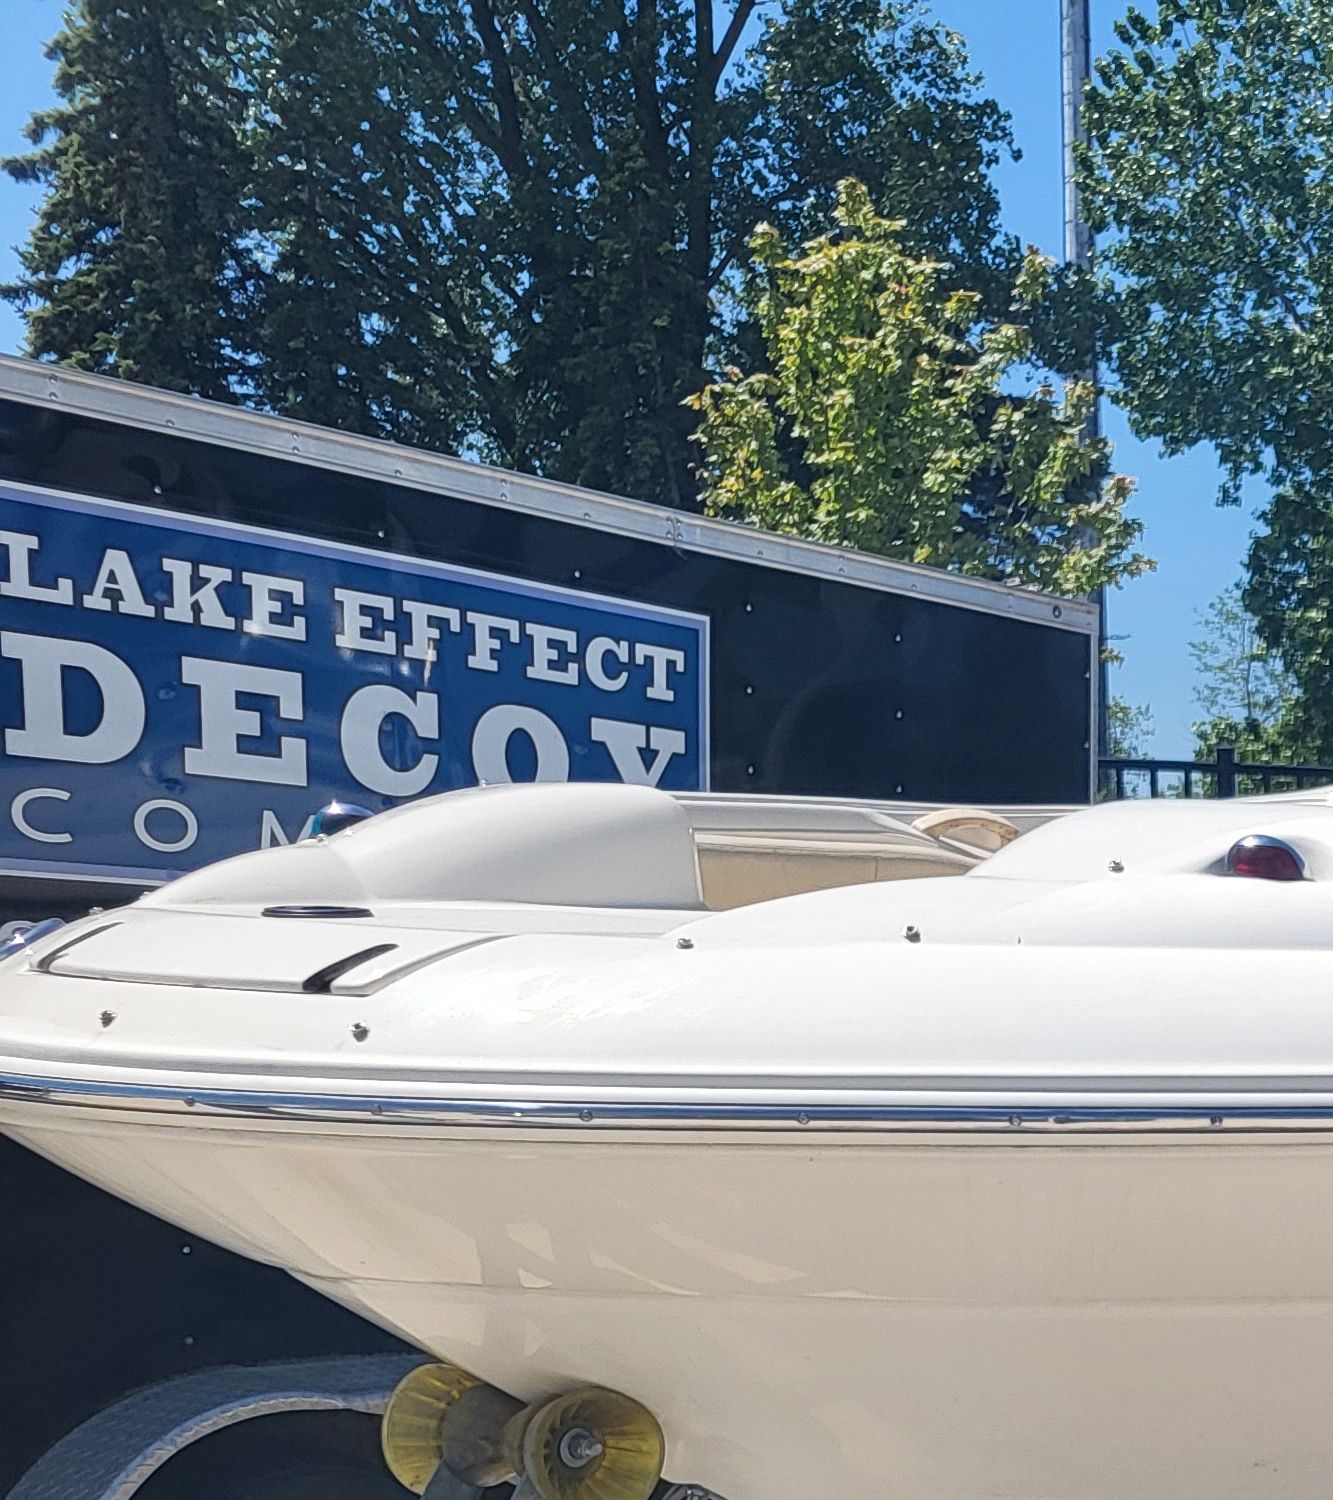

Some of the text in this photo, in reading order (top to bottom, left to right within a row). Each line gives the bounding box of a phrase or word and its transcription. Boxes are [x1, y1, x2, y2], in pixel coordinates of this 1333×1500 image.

[0, 530, 687, 703] LAKE EFFECT
[1, 629, 687, 798] DECOY
